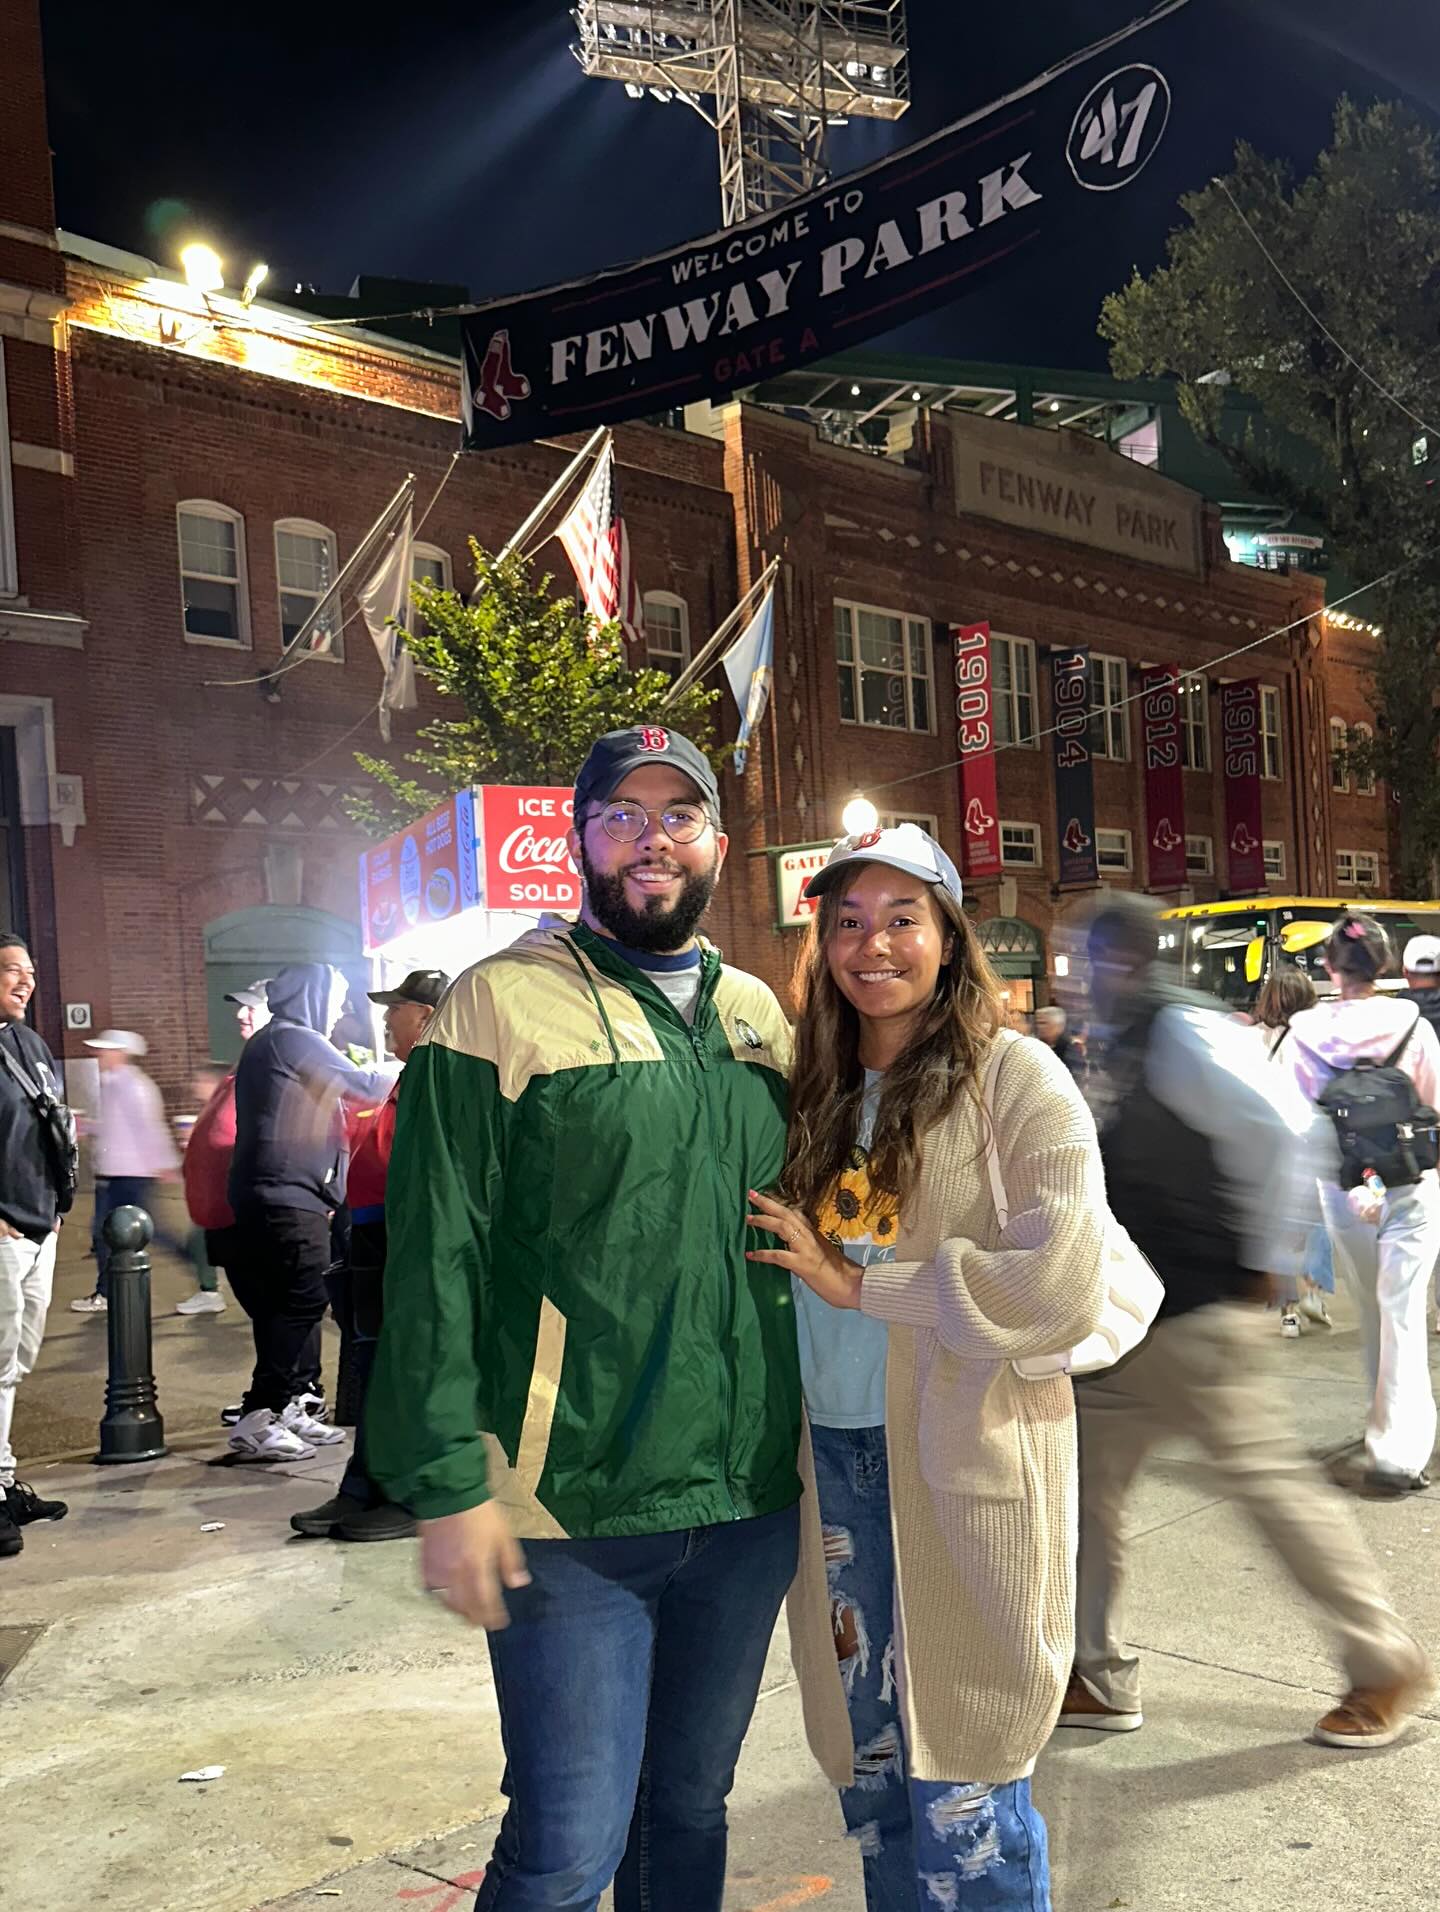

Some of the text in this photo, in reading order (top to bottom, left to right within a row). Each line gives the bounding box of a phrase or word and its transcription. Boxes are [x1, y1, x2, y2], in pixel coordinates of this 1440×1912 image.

[551, 151, 1043, 385] FENWAY PARK
[672, 190, 864, 285] WELCOME TO
[714, 327, 820, 382] GATE A
[979, 460, 1180, 550] FENWAY PARK
[954, 632, 990, 753] 1903
[1054, 653, 1089, 768] 1904
[1144, 672, 1178, 769] 1912
[1223, 687, 1256, 778] 1915
[637, 725, 670, 752] B
[518, 798, 556, 817] ICE
[509, 883, 574, 901] SOLD
[784, 855, 829, 871] GATE
